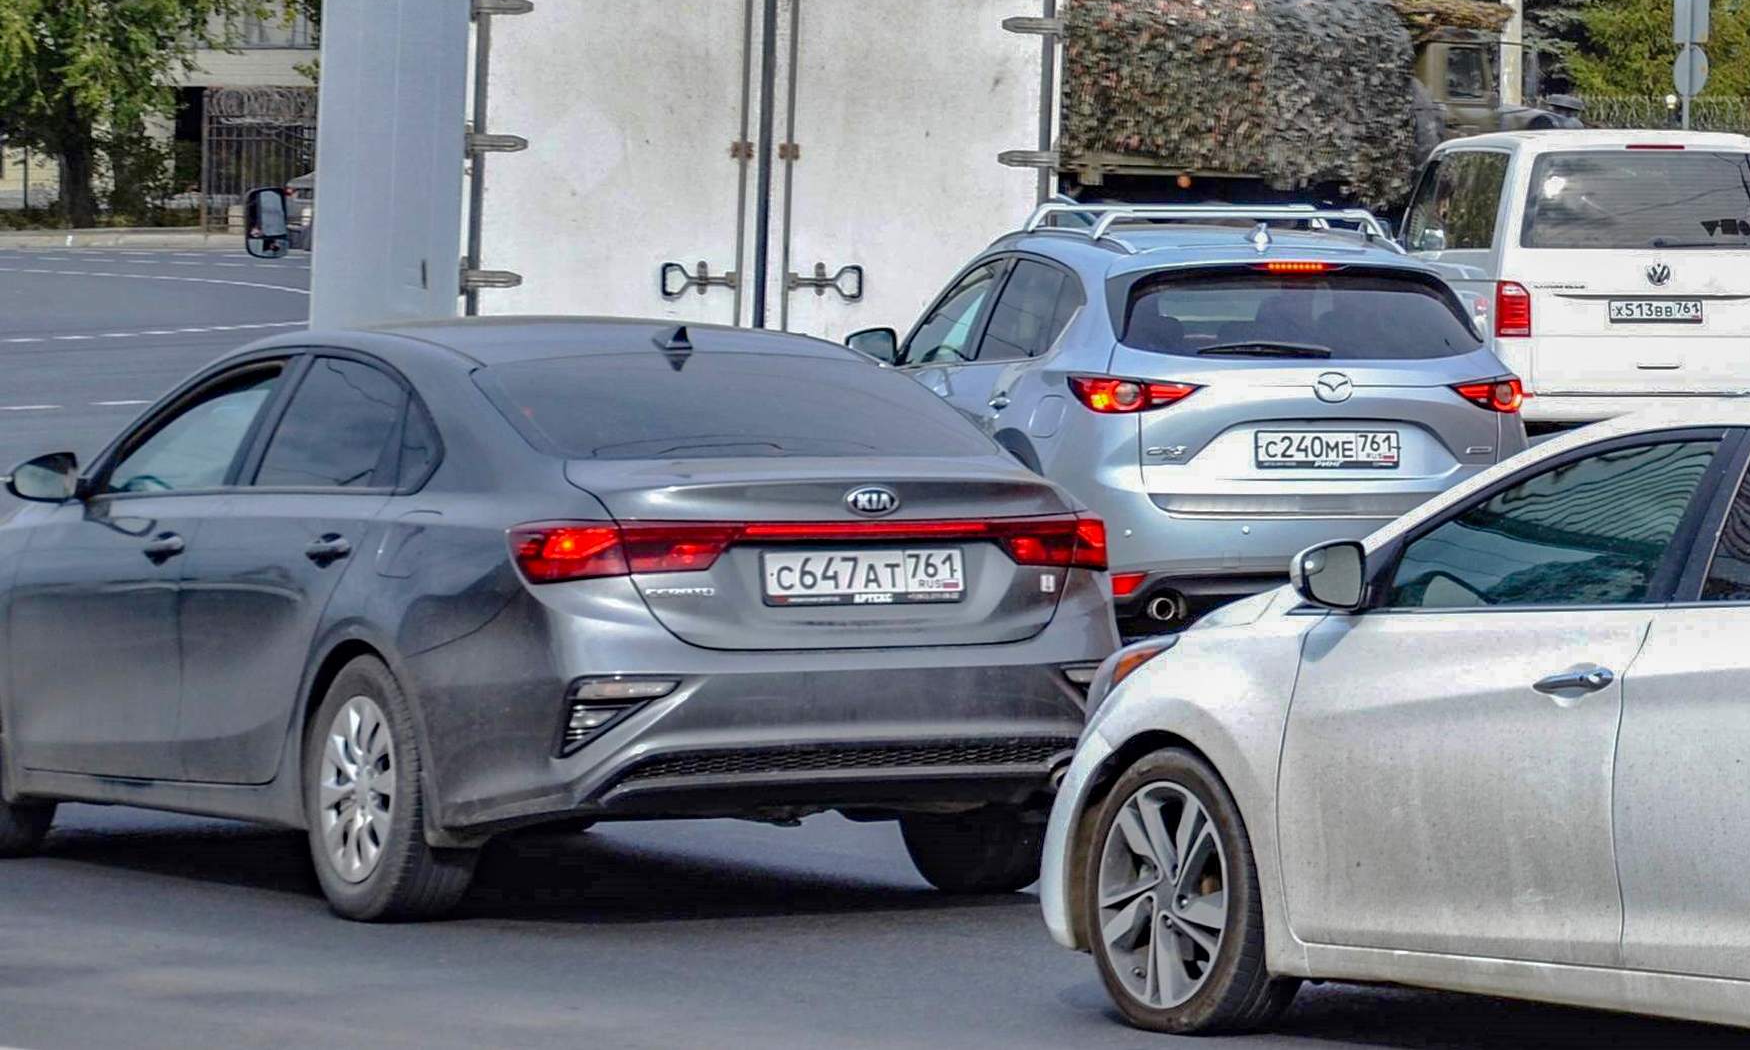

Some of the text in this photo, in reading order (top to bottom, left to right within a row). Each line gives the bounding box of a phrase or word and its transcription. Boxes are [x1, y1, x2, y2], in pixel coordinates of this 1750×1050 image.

[1615, 302, 1699, 317] Х513ВВ 761
[1265, 434, 1392, 459] С240МЕ 761
[857, 493, 891, 510] KIA
[776, 553, 955, 591] С647АТ 761
[918, 579, 942, 589] RUS
